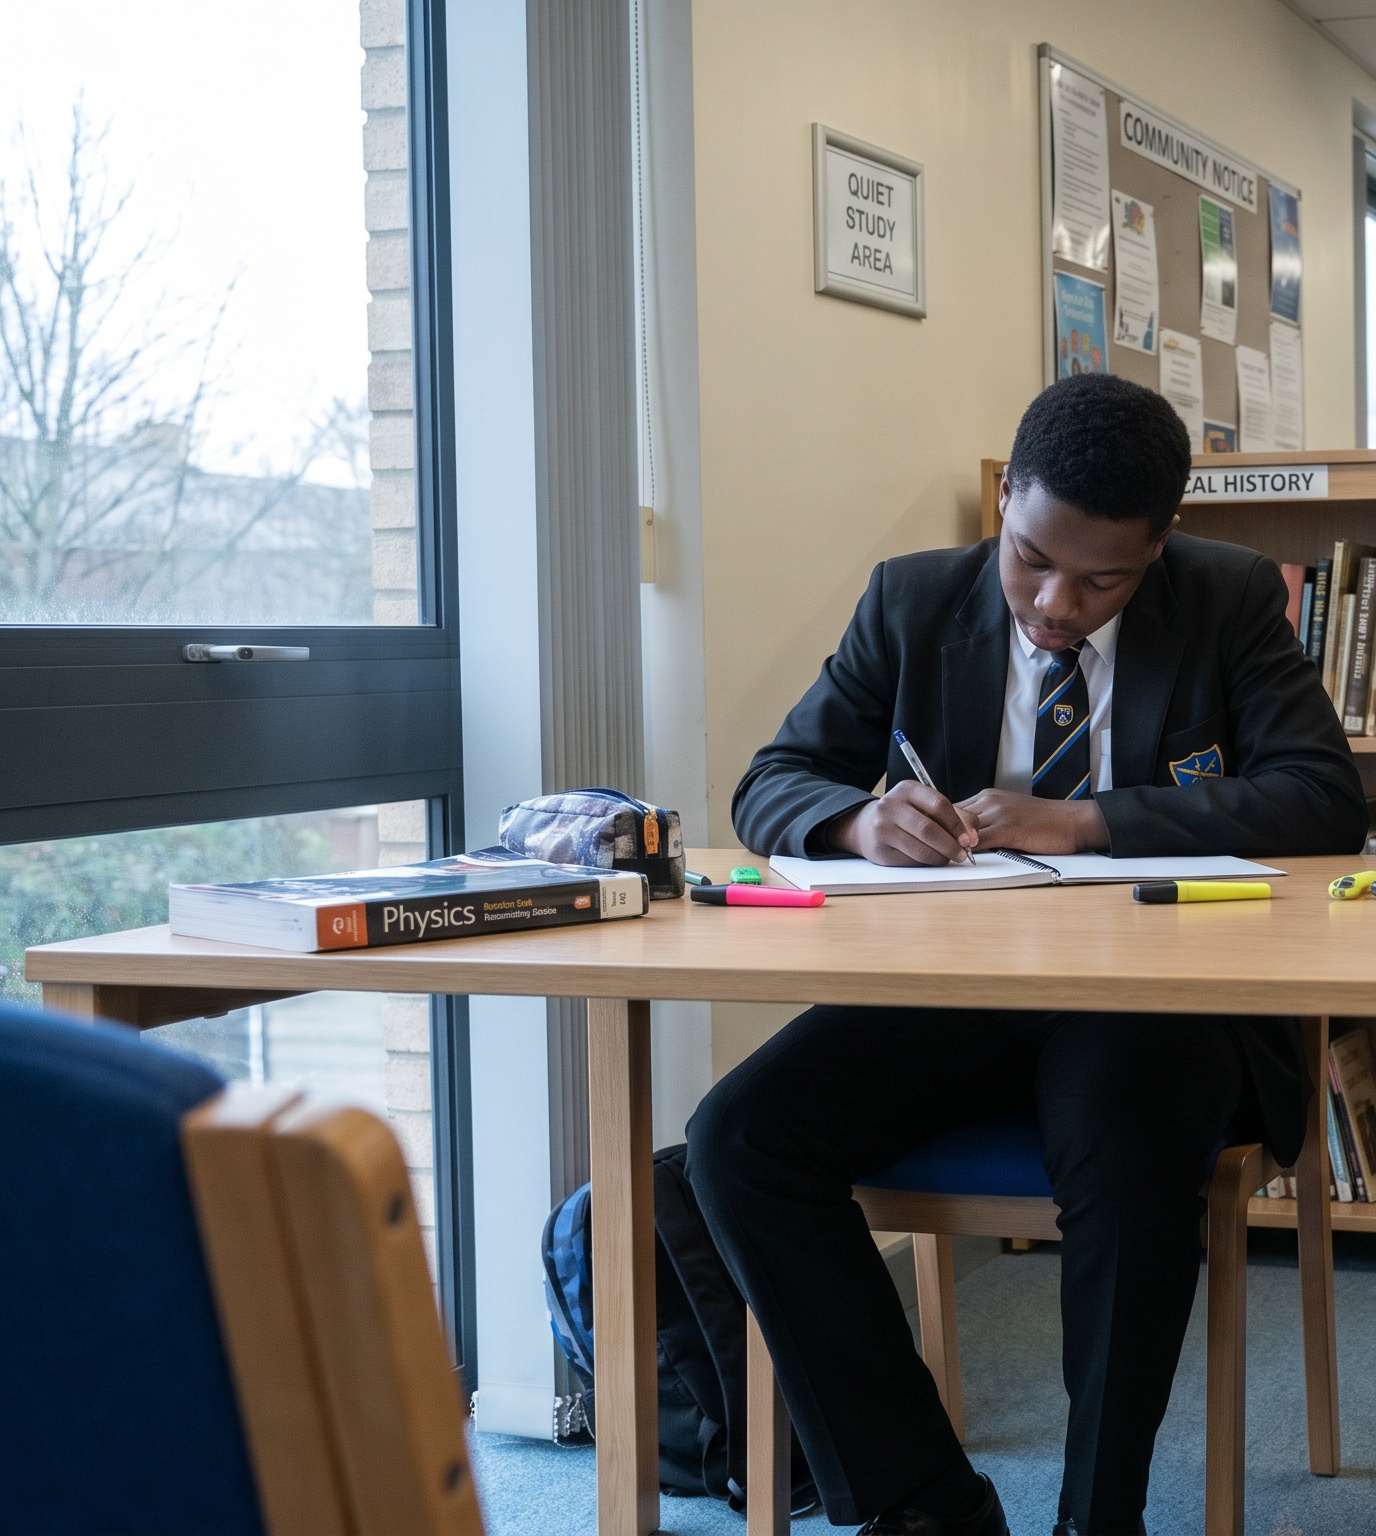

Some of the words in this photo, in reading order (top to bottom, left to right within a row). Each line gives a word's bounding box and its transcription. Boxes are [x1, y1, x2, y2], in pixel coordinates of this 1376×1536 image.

[1123, 111, 1208, 180] COMMUNITY
[1212, 159, 1254, 205] NOTICE
[848, 172, 894, 208] QUIET
[846, 205, 896, 242] STUDY
[850, 242, 893, 275] AREA
[1224, 472, 1314, 493] HISTORY
[383, 901, 476, 938] Physics
